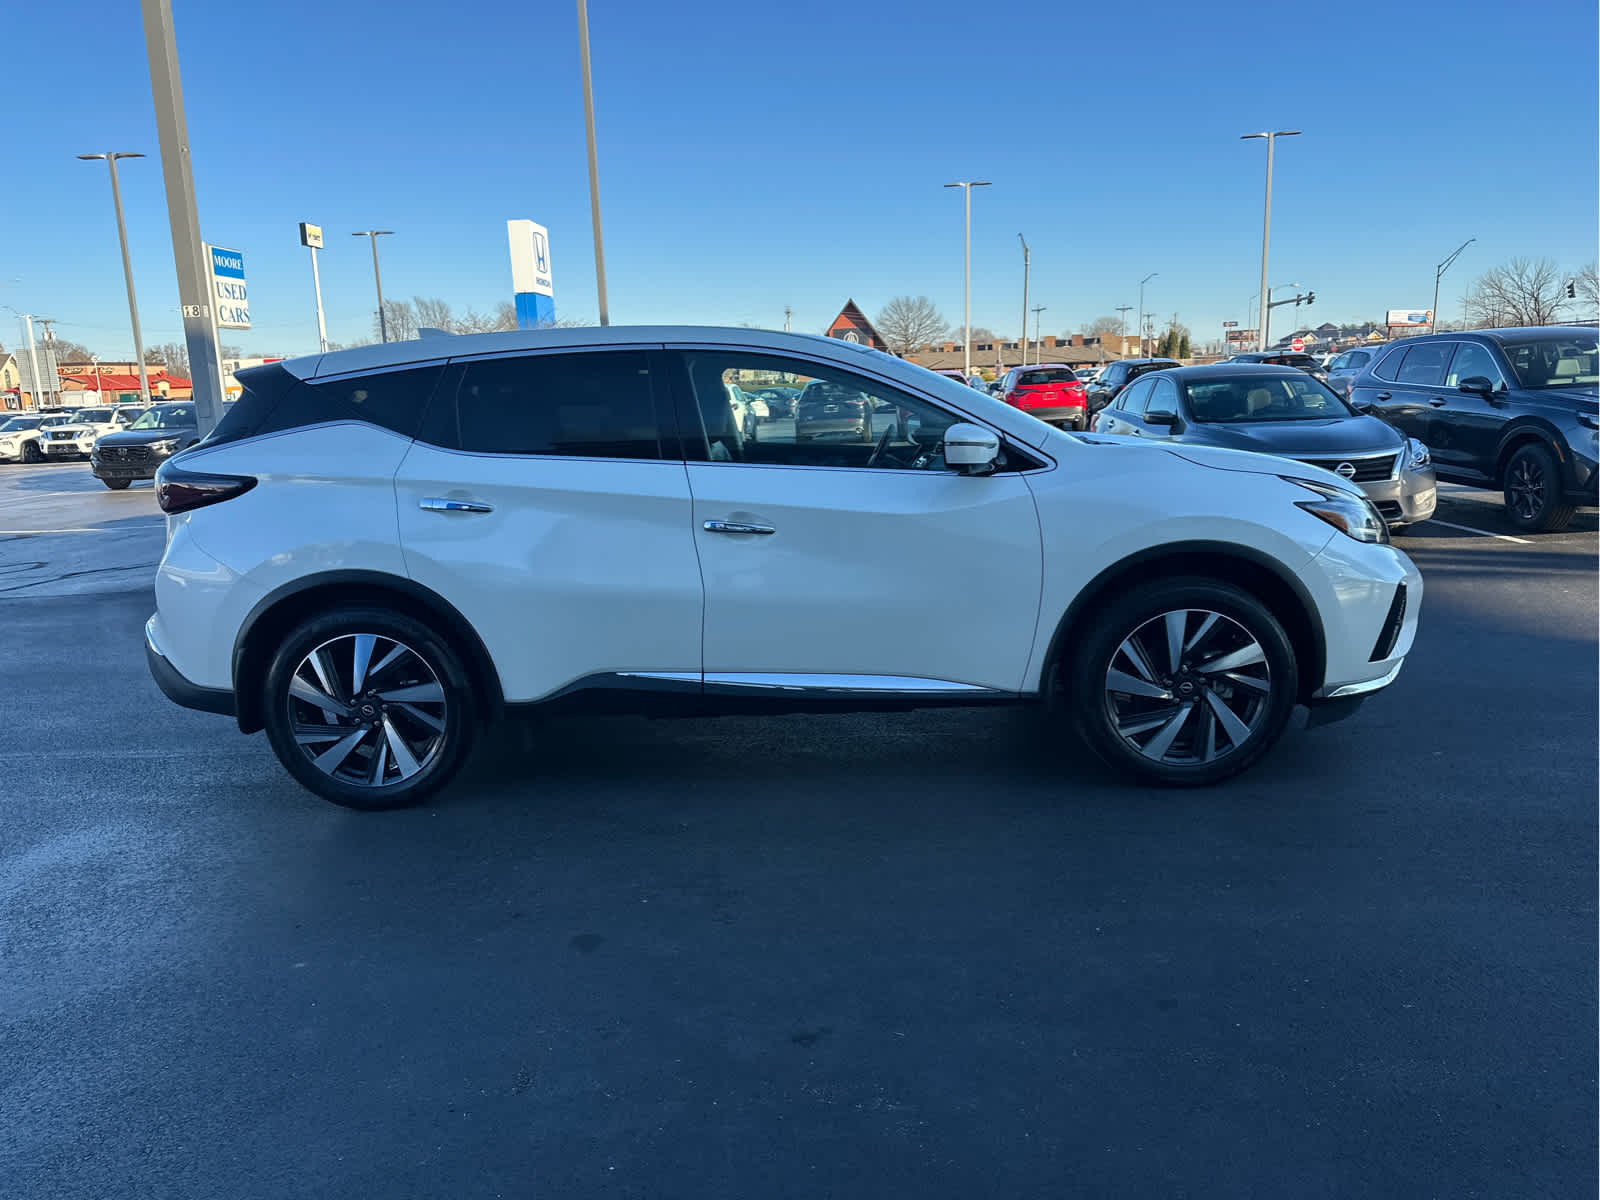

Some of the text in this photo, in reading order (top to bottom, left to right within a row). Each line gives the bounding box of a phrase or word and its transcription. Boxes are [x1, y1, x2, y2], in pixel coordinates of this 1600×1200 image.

[214, 255, 243, 270] MOORE
[216, 281, 247, 300] USED
[219, 304, 250, 324] CARS
